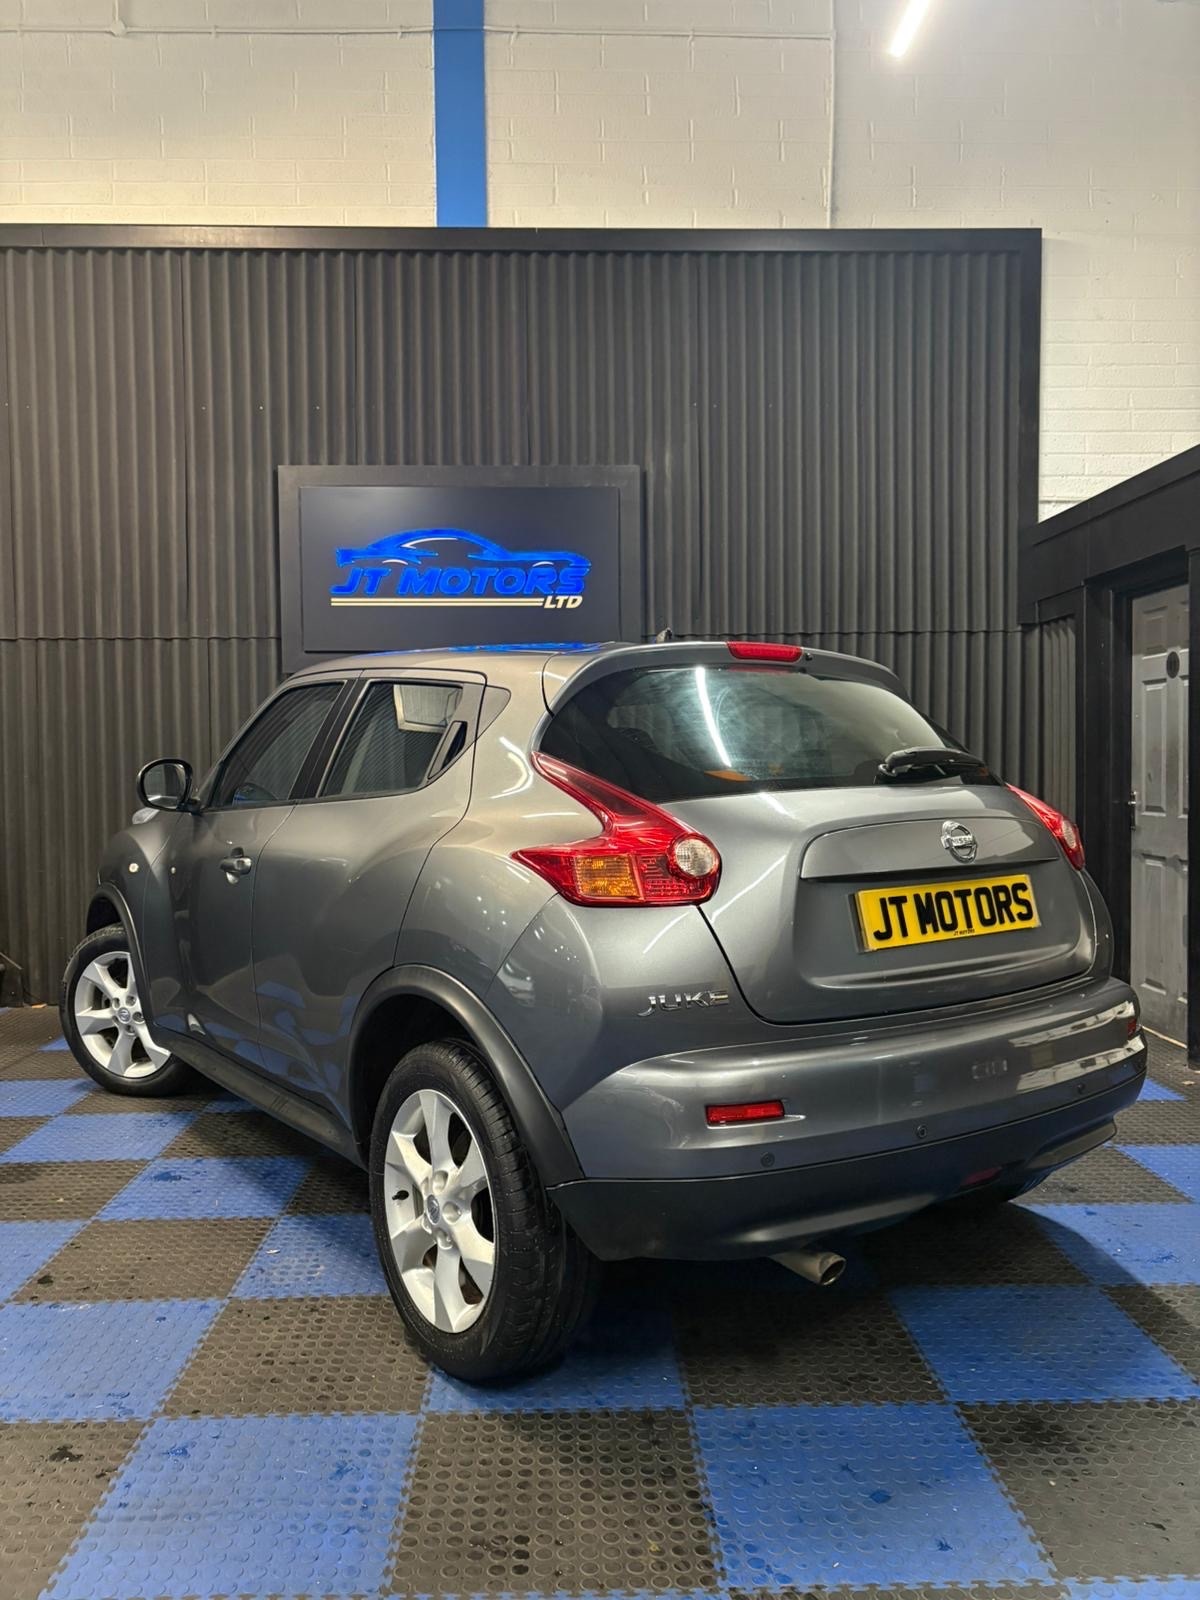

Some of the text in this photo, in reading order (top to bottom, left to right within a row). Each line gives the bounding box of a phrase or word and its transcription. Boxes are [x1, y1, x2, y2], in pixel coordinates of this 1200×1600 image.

[329, 567, 591, 595] JT MOTORS
[543, 595, 583, 609] LTD
[873, 882, 1034, 940] JT MOTORS
[638, 990, 729, 1017] JUKE
